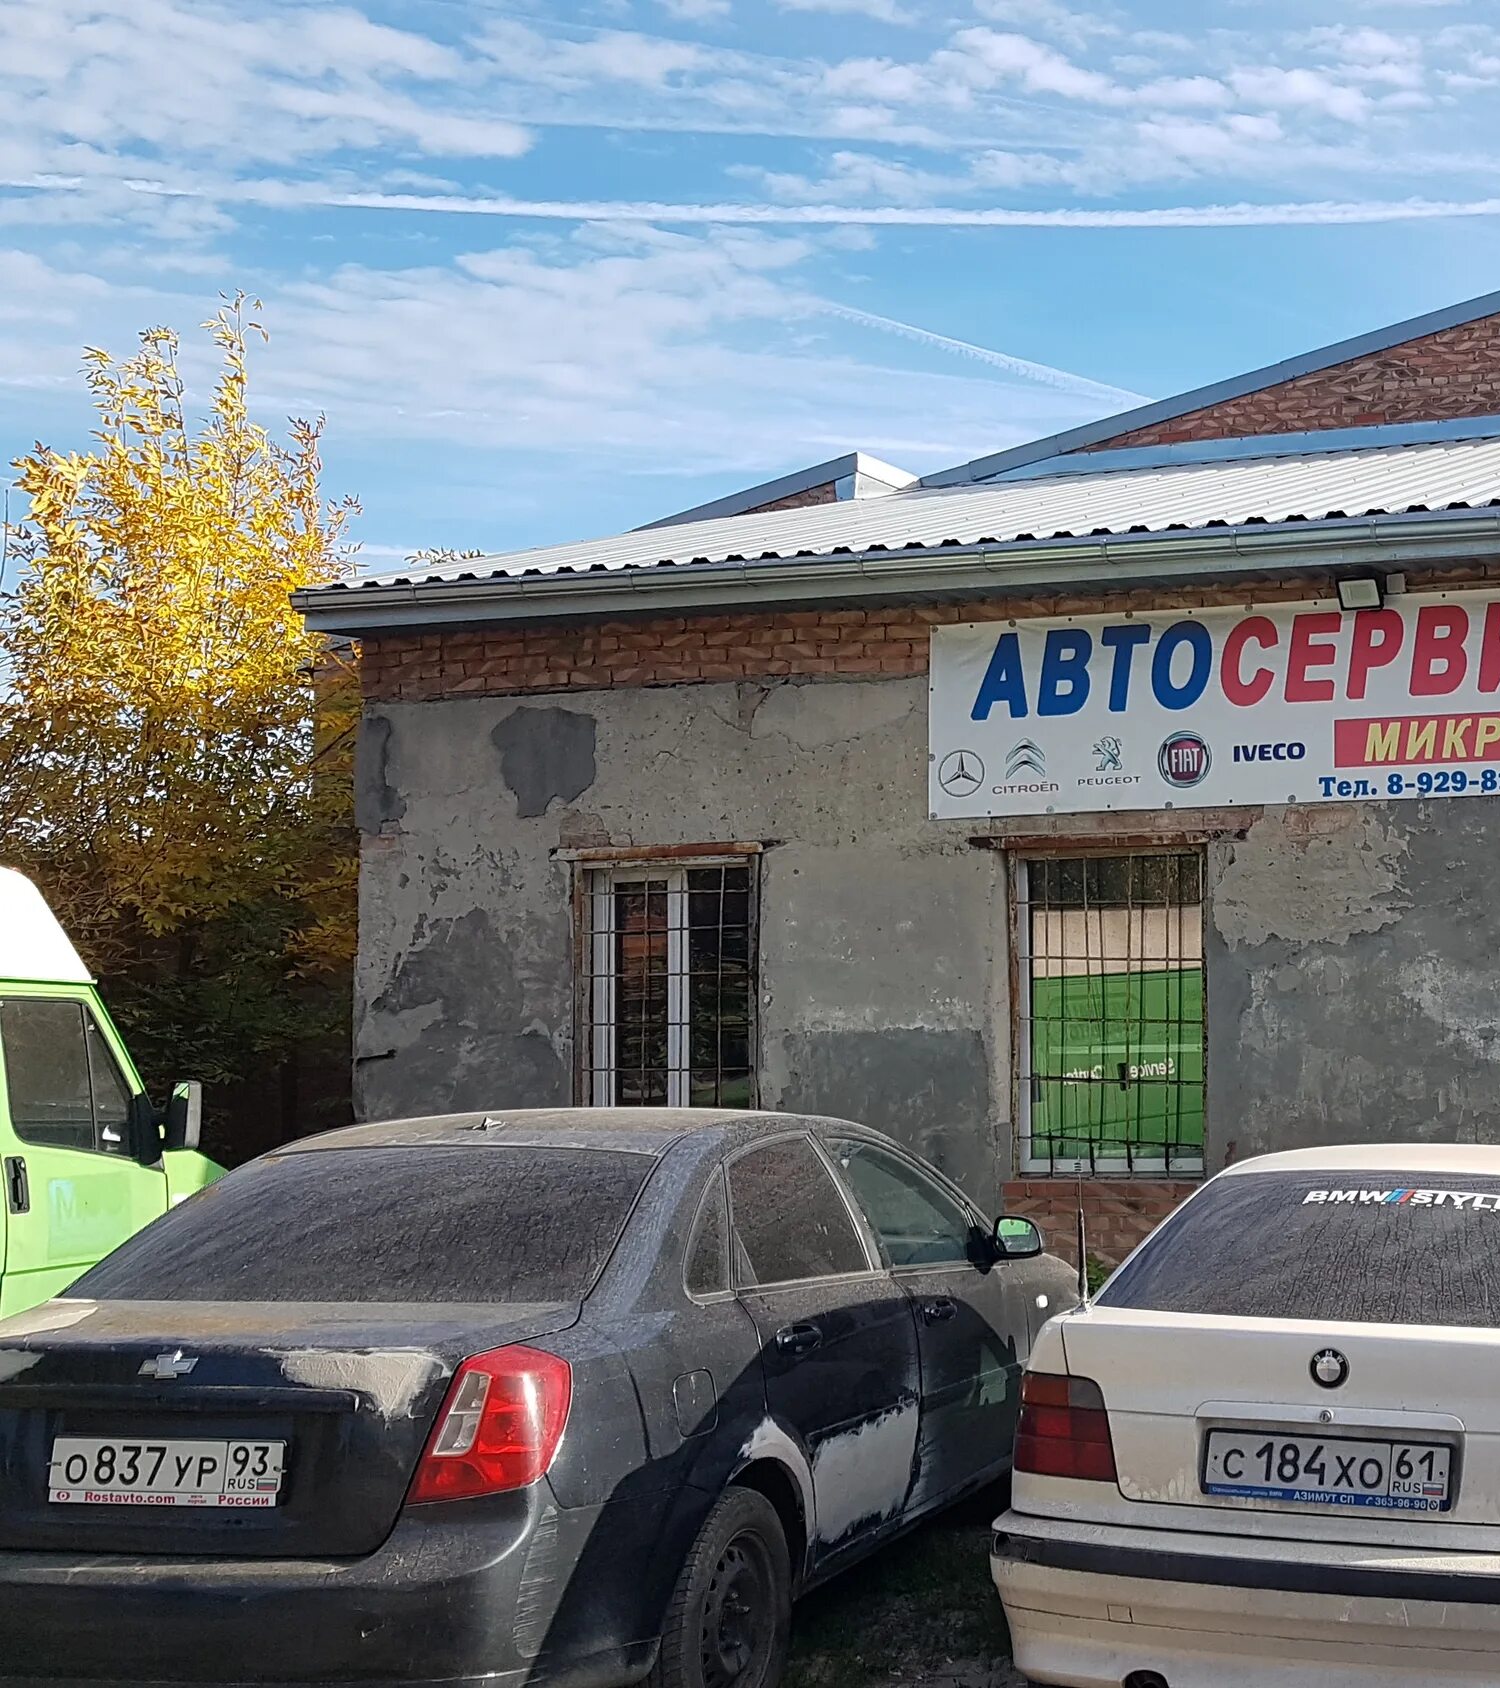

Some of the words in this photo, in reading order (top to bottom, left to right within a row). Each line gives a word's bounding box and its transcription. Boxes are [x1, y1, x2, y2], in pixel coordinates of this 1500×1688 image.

[1171, 748, 1200, 773] FIAT
[1233, 742, 1306, 763] IVECO
[1077, 775, 1142, 787] PEUGEOT
[1318, 775, 1378, 799] Тел.
[1313, 1350, 1344, 1364] BMW
[232, 1446, 270, 1477] 93
[1396, 1448, 1435, 1481] 61
[227, 1478, 256, 1490] RUS
[1392, 1481, 1421, 1494] RUS
[84, 1491, 176, 1505] Rostavto.com
[217, 1494, 270, 1506] России
[1293, 1490, 1337, 1504] АЗИМУТ
[1340, 1492, 1355, 1505] СП
[1374, 1497, 1427, 1509] 363-96-96
